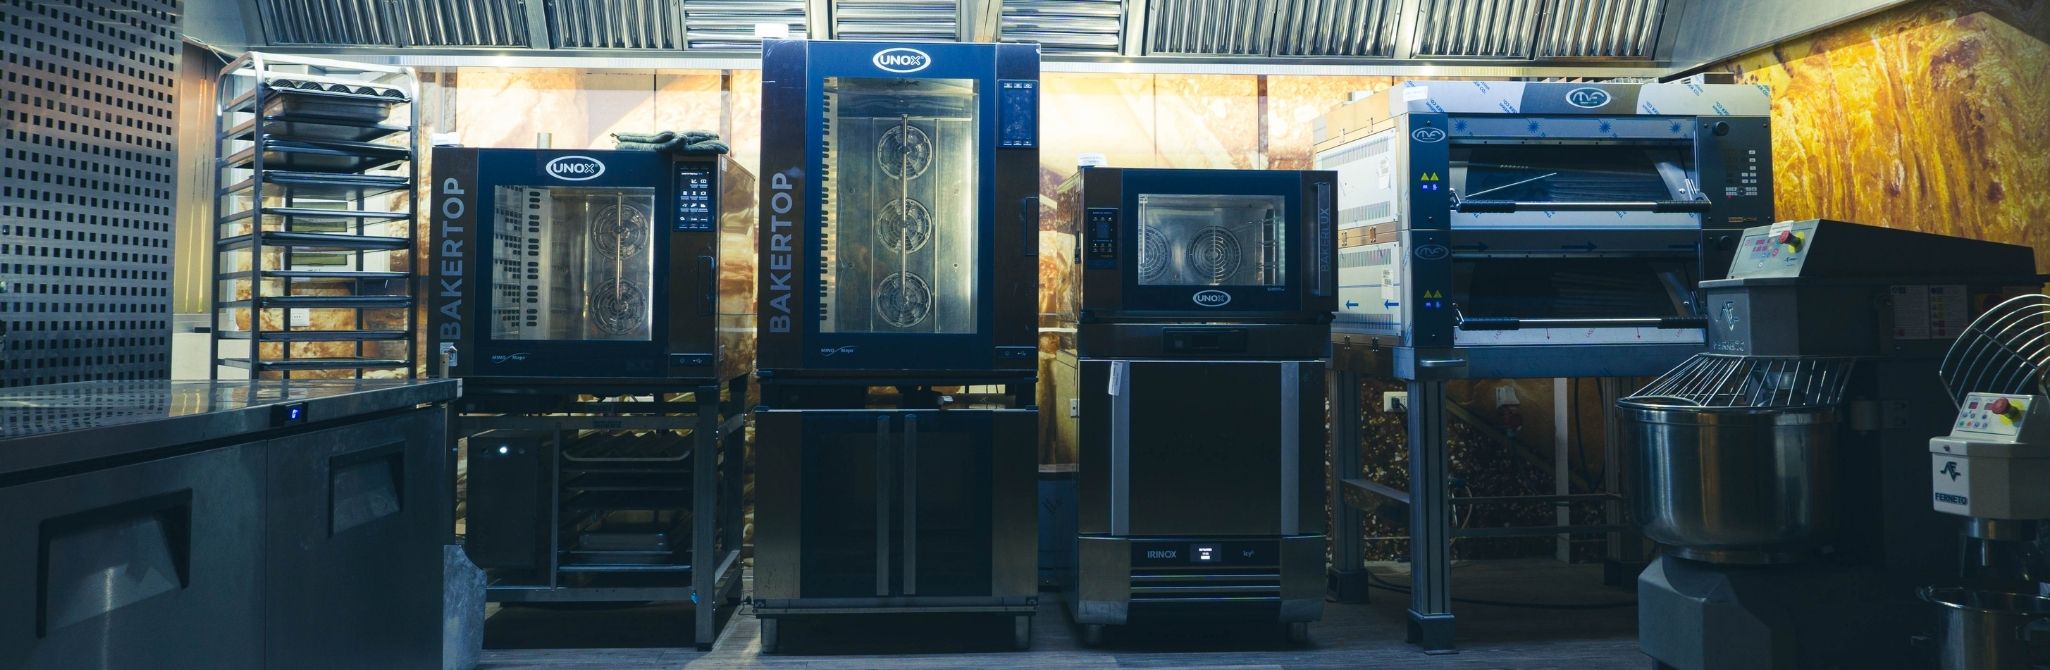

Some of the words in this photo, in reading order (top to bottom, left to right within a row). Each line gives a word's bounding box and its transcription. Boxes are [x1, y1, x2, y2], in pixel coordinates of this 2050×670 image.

[880, 55, 920, 65] UNOX
[553, 163, 594, 173] UNOX
[1320, 207, 1329, 272] BAKERLUX
[440, 177, 465, 339] BAKERTOP
[770, 172, 793, 333] BAKERTOP
[1197, 294, 1225, 302] UNOX
[1935, 492, 1968, 506] FERNETO
[1147, 550, 1177, 559] IRINOX
